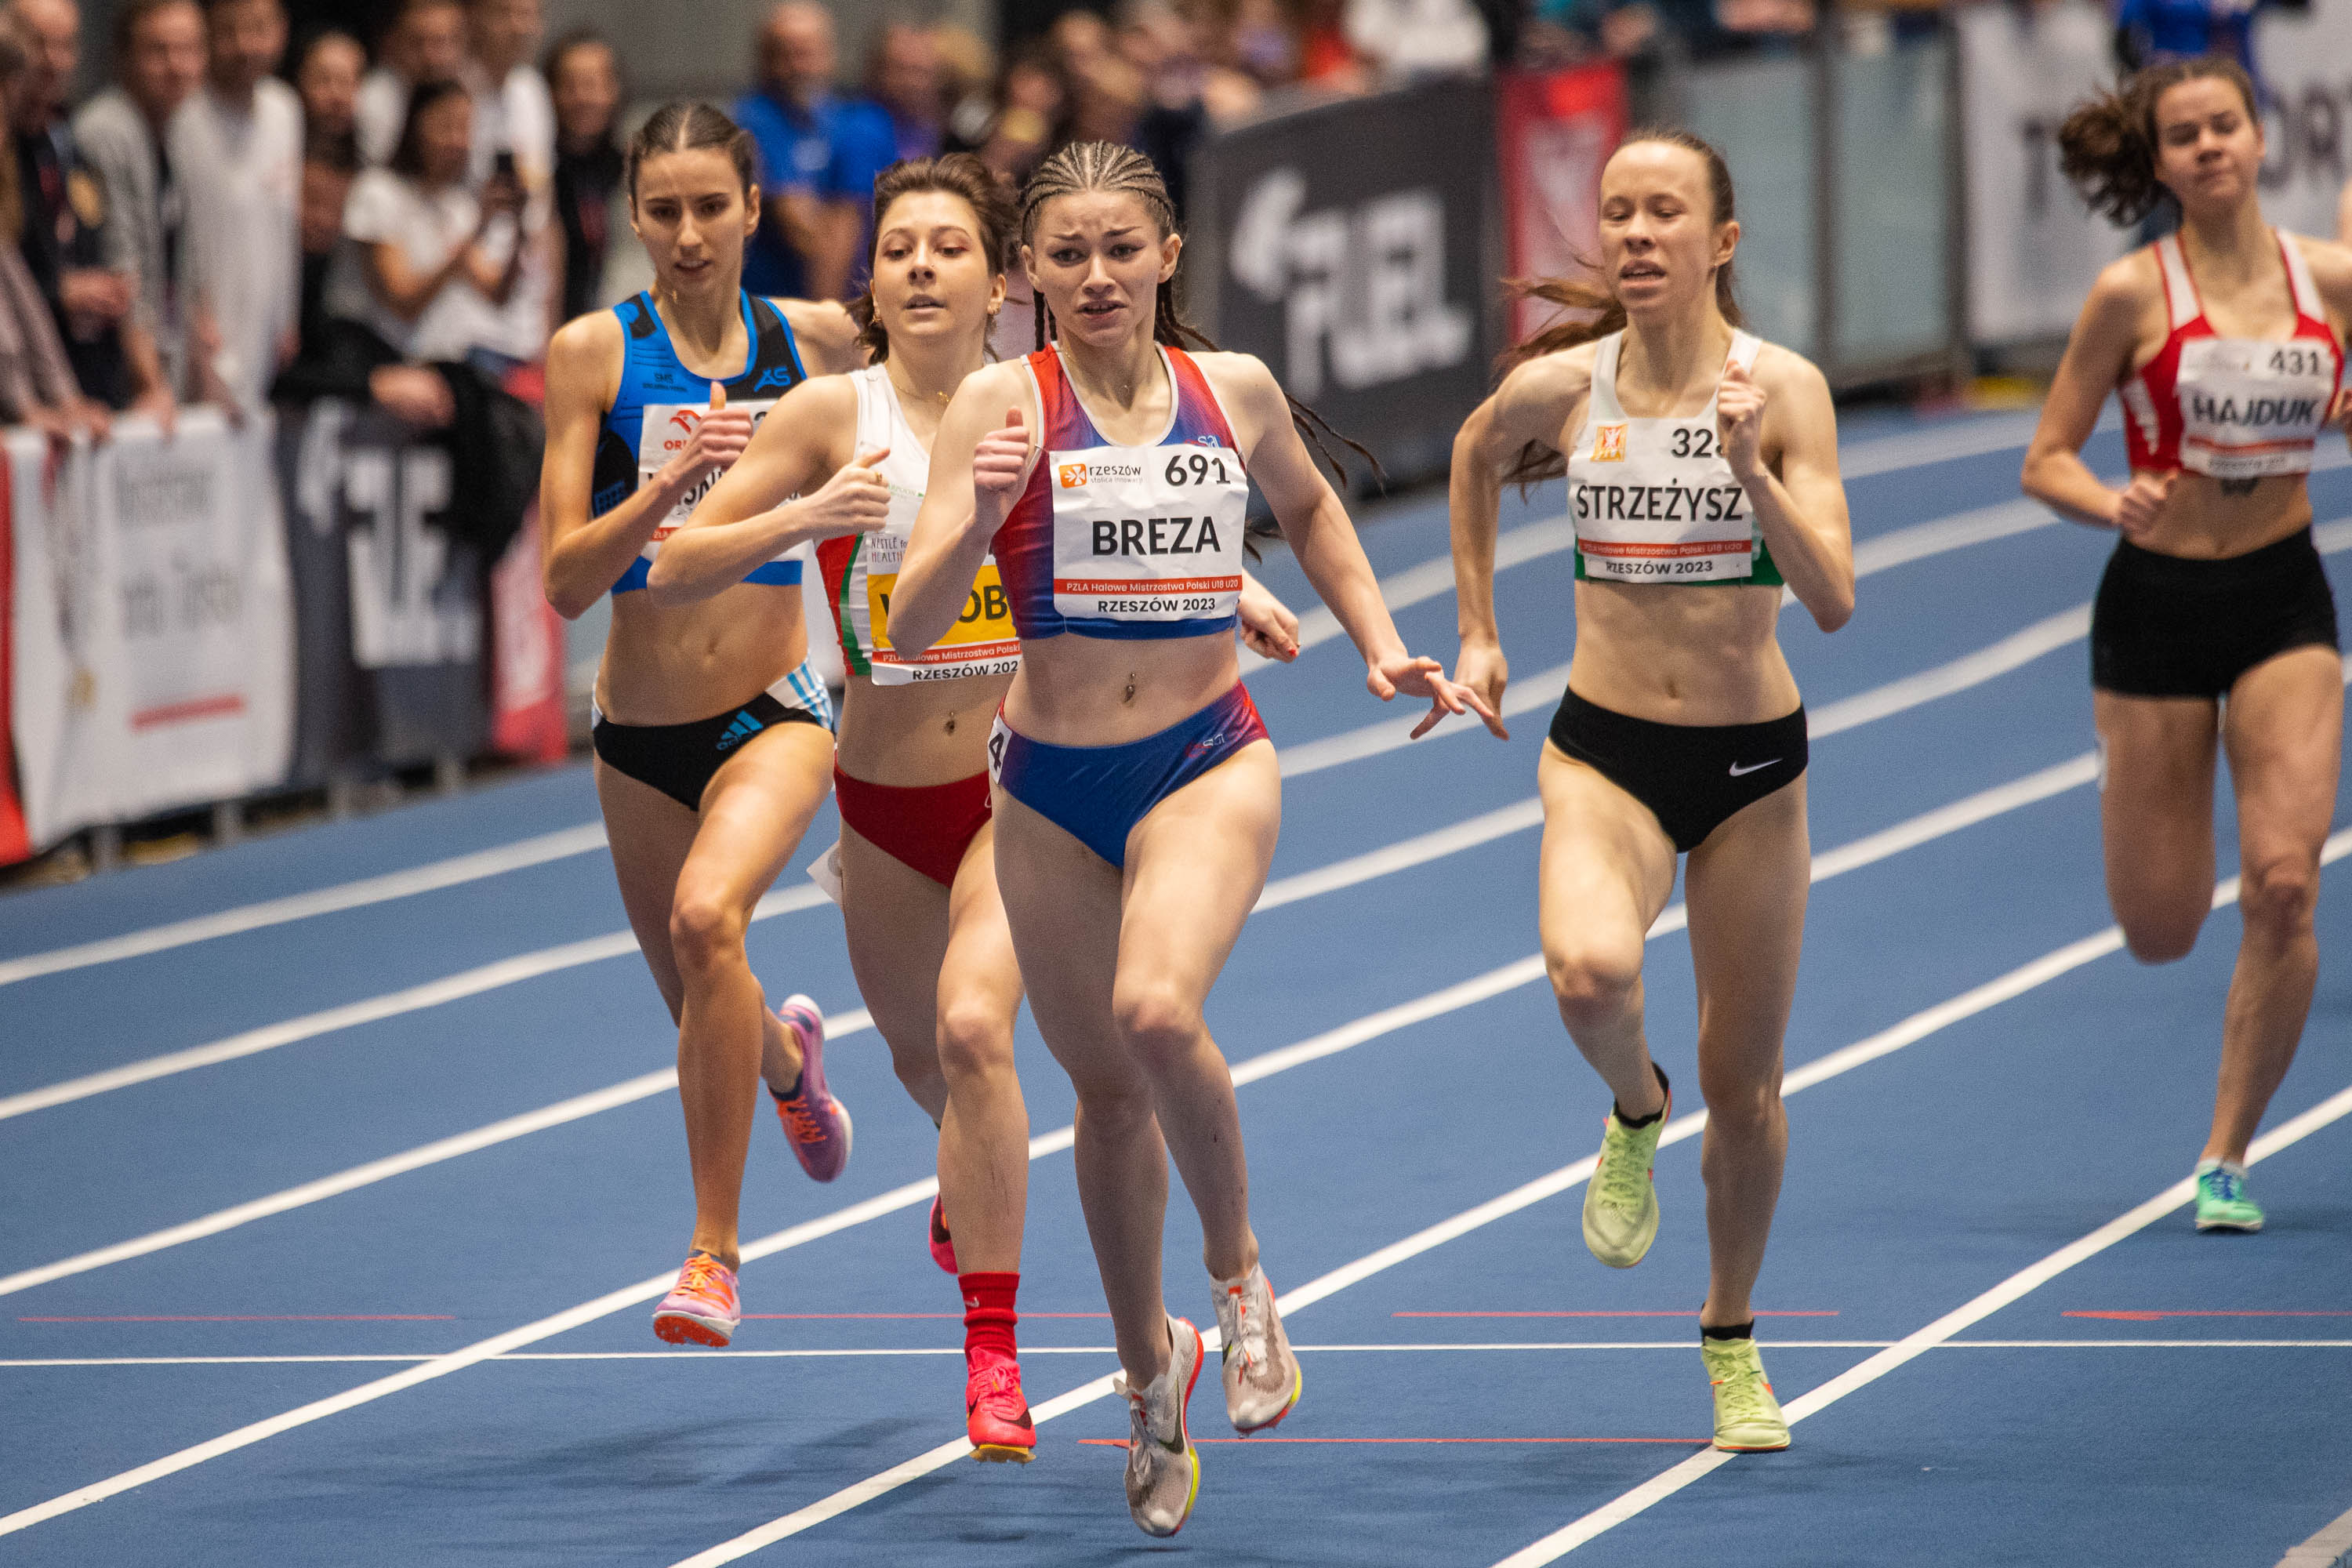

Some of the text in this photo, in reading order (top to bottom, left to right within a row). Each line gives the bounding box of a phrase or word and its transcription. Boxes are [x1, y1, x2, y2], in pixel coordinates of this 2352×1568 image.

[2269, 348, 2321, 376] 431
[2192, 395, 2318, 426] HAJDUK
[1089, 465, 1142, 476] rzeszów
[1165, 454, 1231, 486] 691
[1576, 477, 1744, 522] STRZEŻYSZ
[1092, 516, 1221, 556] BREZA
[1626, 546, 1678, 556] Mistrzostwa
[1679, 545, 1704, 554] Polski
[1606, 561, 1713, 575] RZESZÓW 2023
[1091, 583, 1127, 592] Halowe
[1130, 583, 1185, 592] Mistrzostwa
[1186, 581, 1210, 590] Polski
[1212, 580, 1224, 589] U18
[1225, 579, 1238, 588] U20
[1098, 597, 1215, 612] RZESZÓW 2023
[942, 648, 995, 660] Mistrzostwa
[996, 644, 1020, 654] Polski
[913, 661, 1018, 681] RZESZÓW 202
[988, 731, 1005, 771] 4
